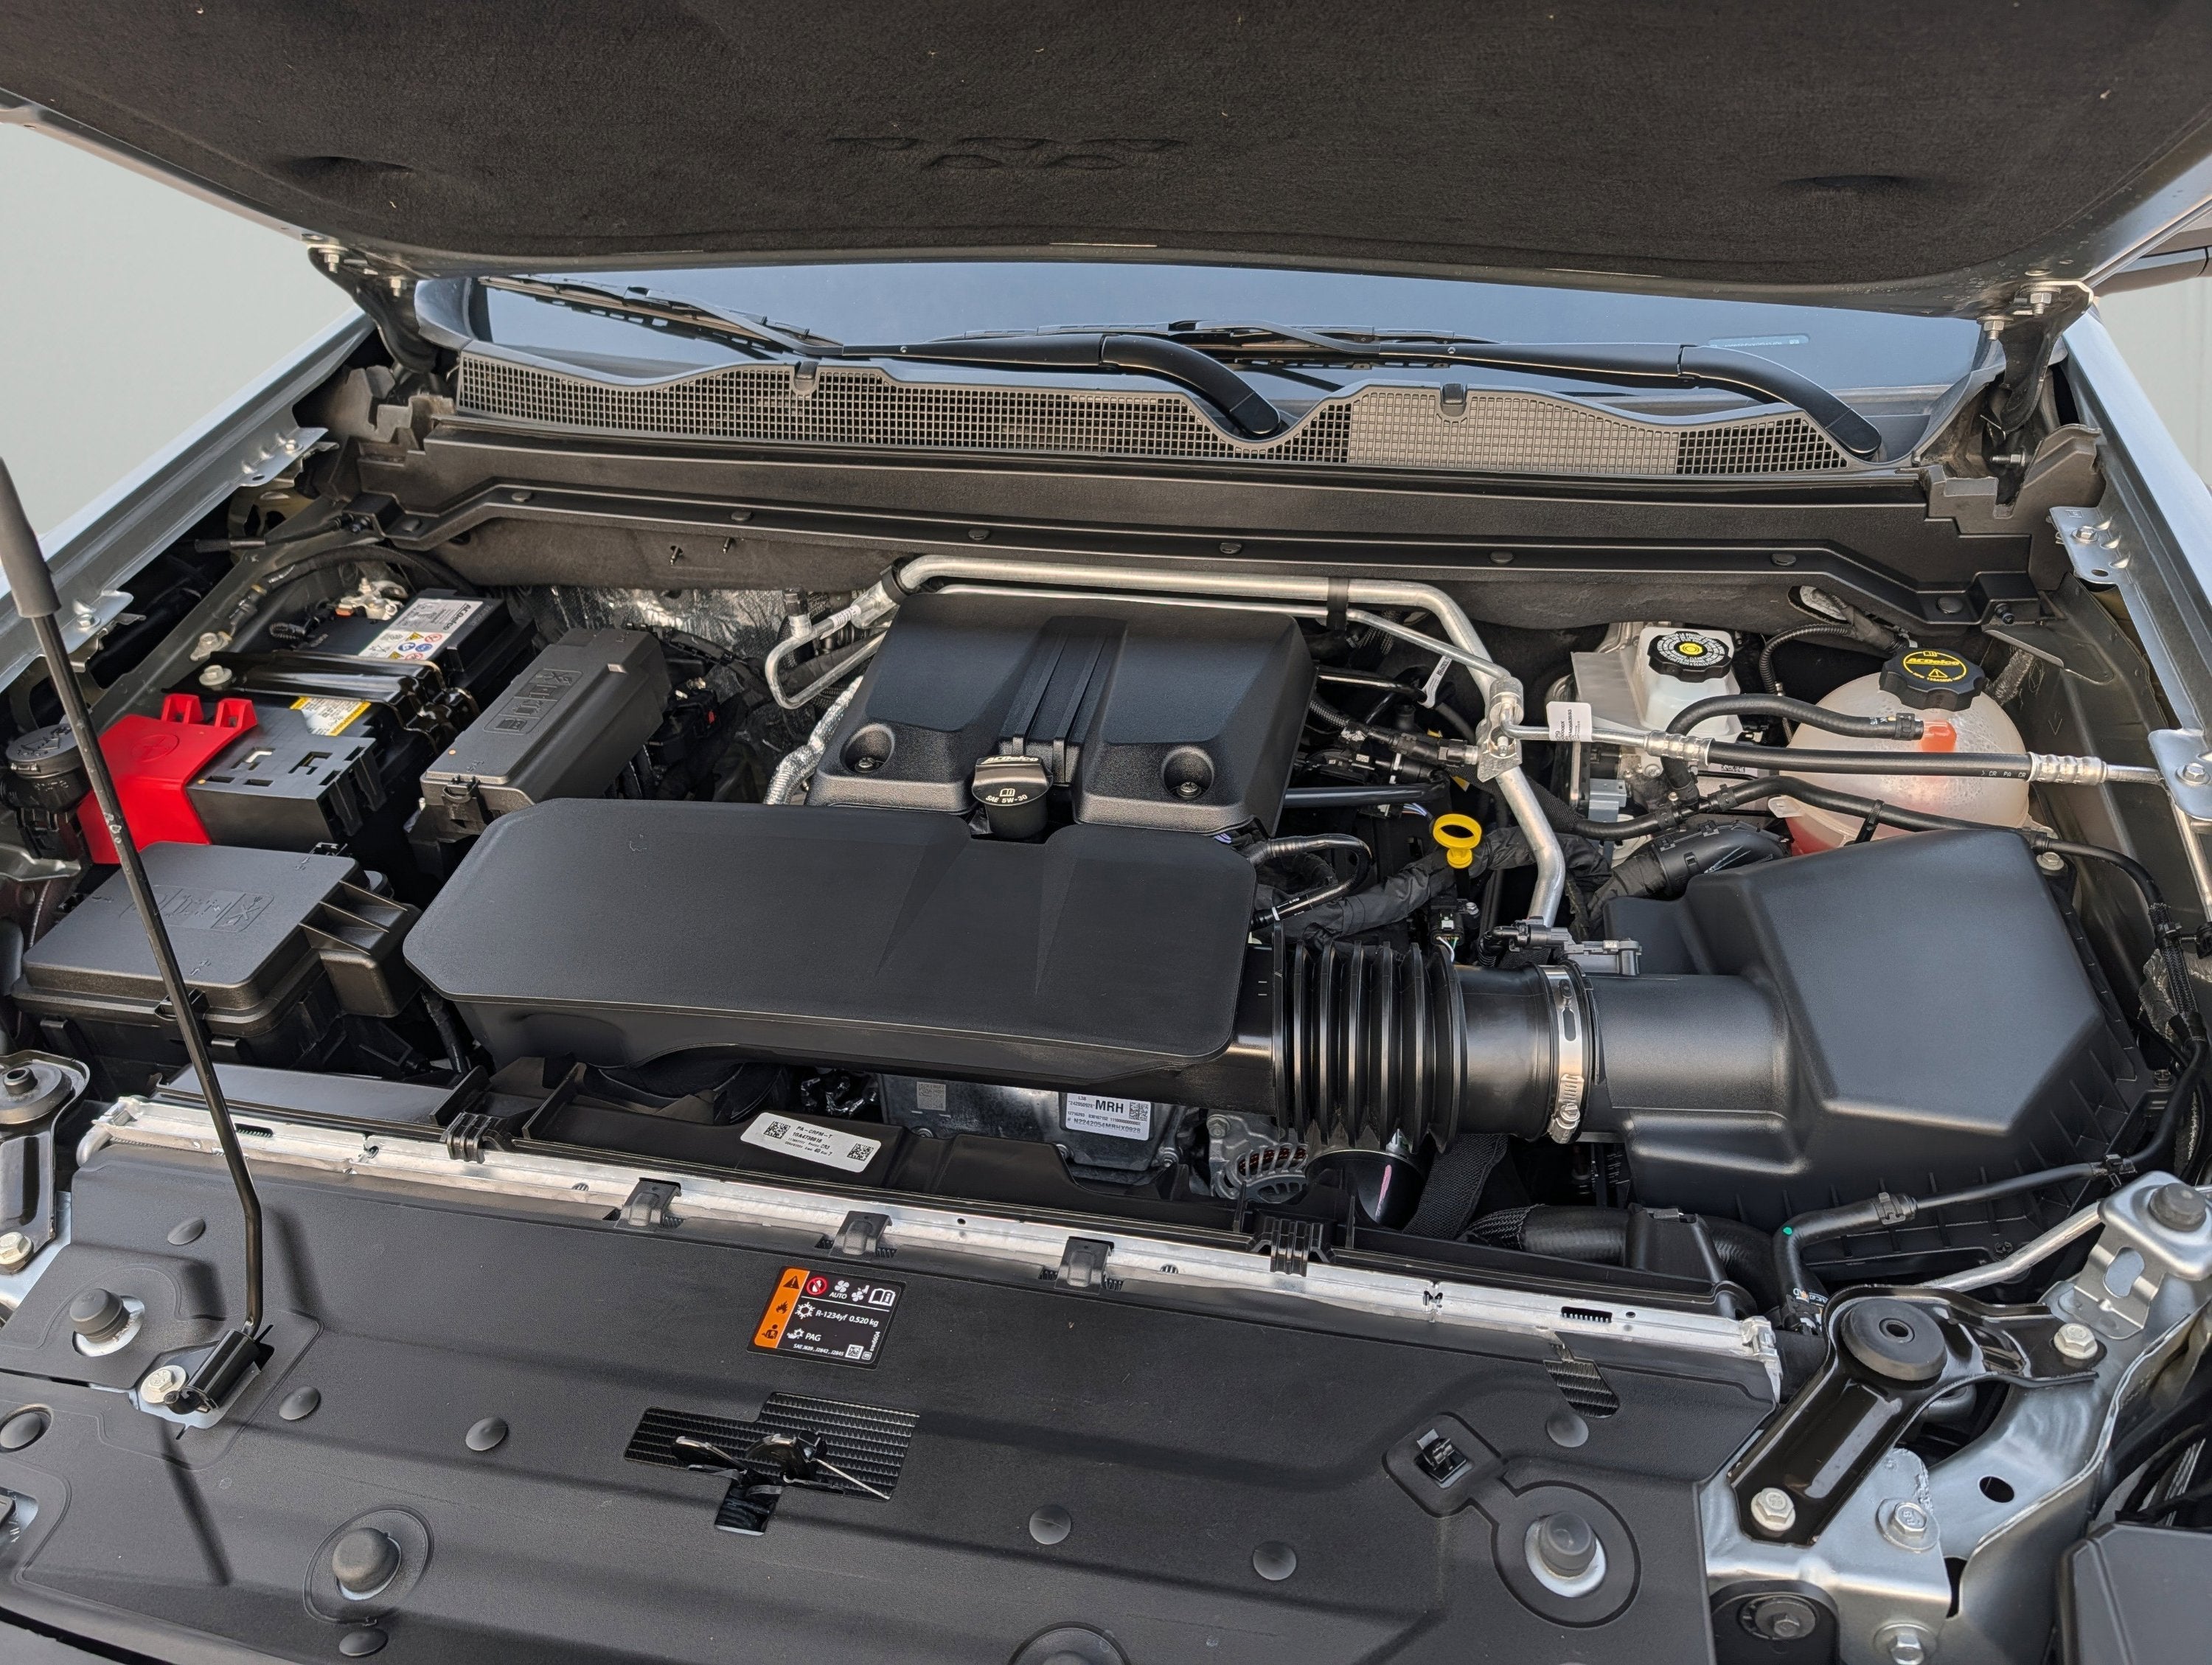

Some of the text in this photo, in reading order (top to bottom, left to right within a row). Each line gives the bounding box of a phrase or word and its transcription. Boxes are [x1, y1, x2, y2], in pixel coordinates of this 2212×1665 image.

[1906, 658, 1961, 666] ACDelco
[981, 756, 1039, 765] ACDelco
[986, 794, 1028, 804] SAE 5W-30
[1096, 1099, 1124, 1113] MRH
[829, 1291, 847, 1299] AUTO
[815, 1310, 879, 1327] R-1234yf 0.520 kg
[804, 1332, 822, 1342] PAG
